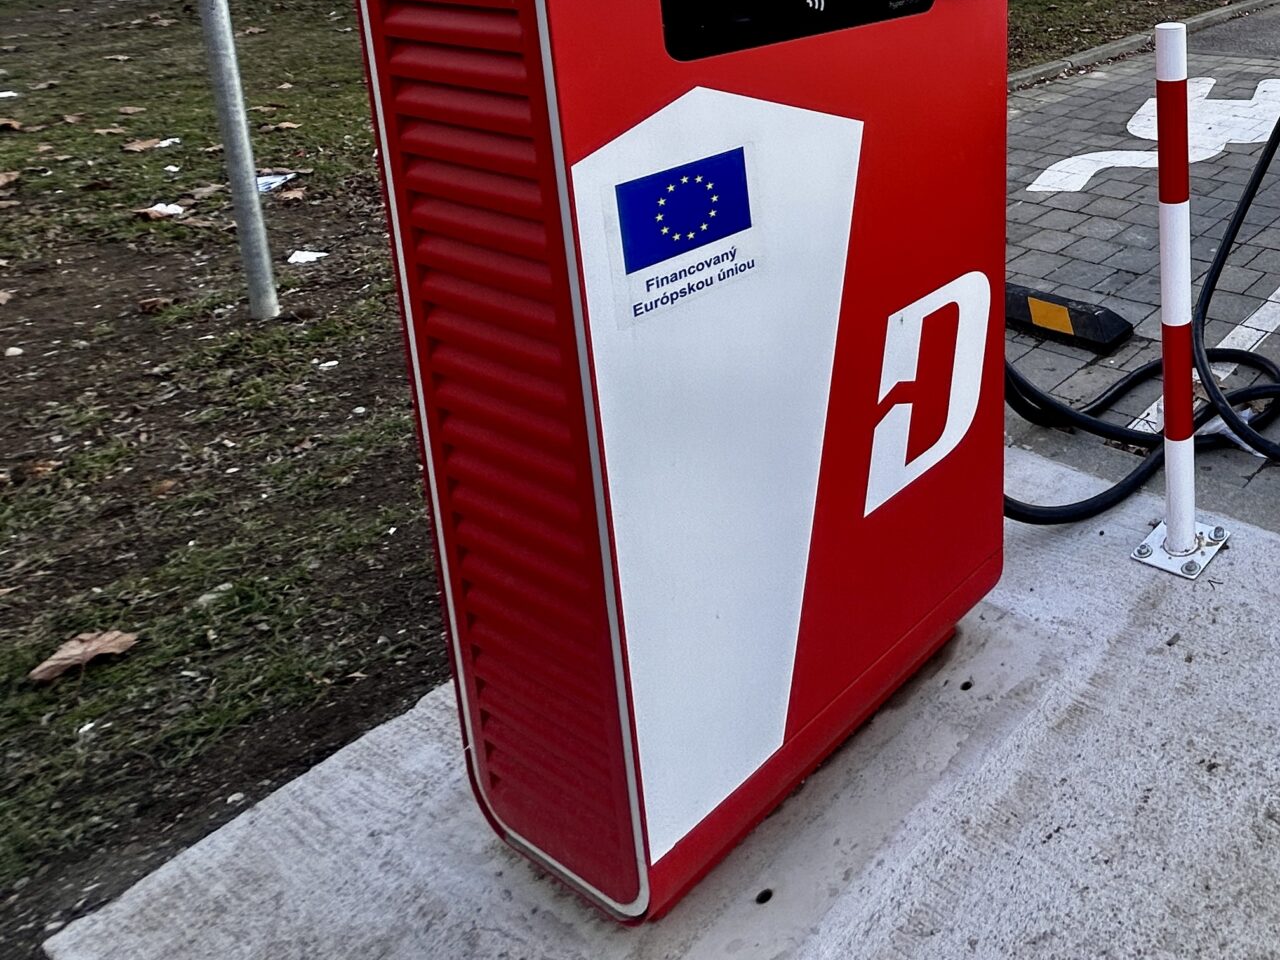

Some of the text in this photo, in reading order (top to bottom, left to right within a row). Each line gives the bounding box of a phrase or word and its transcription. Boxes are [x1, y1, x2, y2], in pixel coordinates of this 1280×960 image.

[633, 258, 755, 317] Európskou úniou
[646, 245, 738, 292] Financovaný
